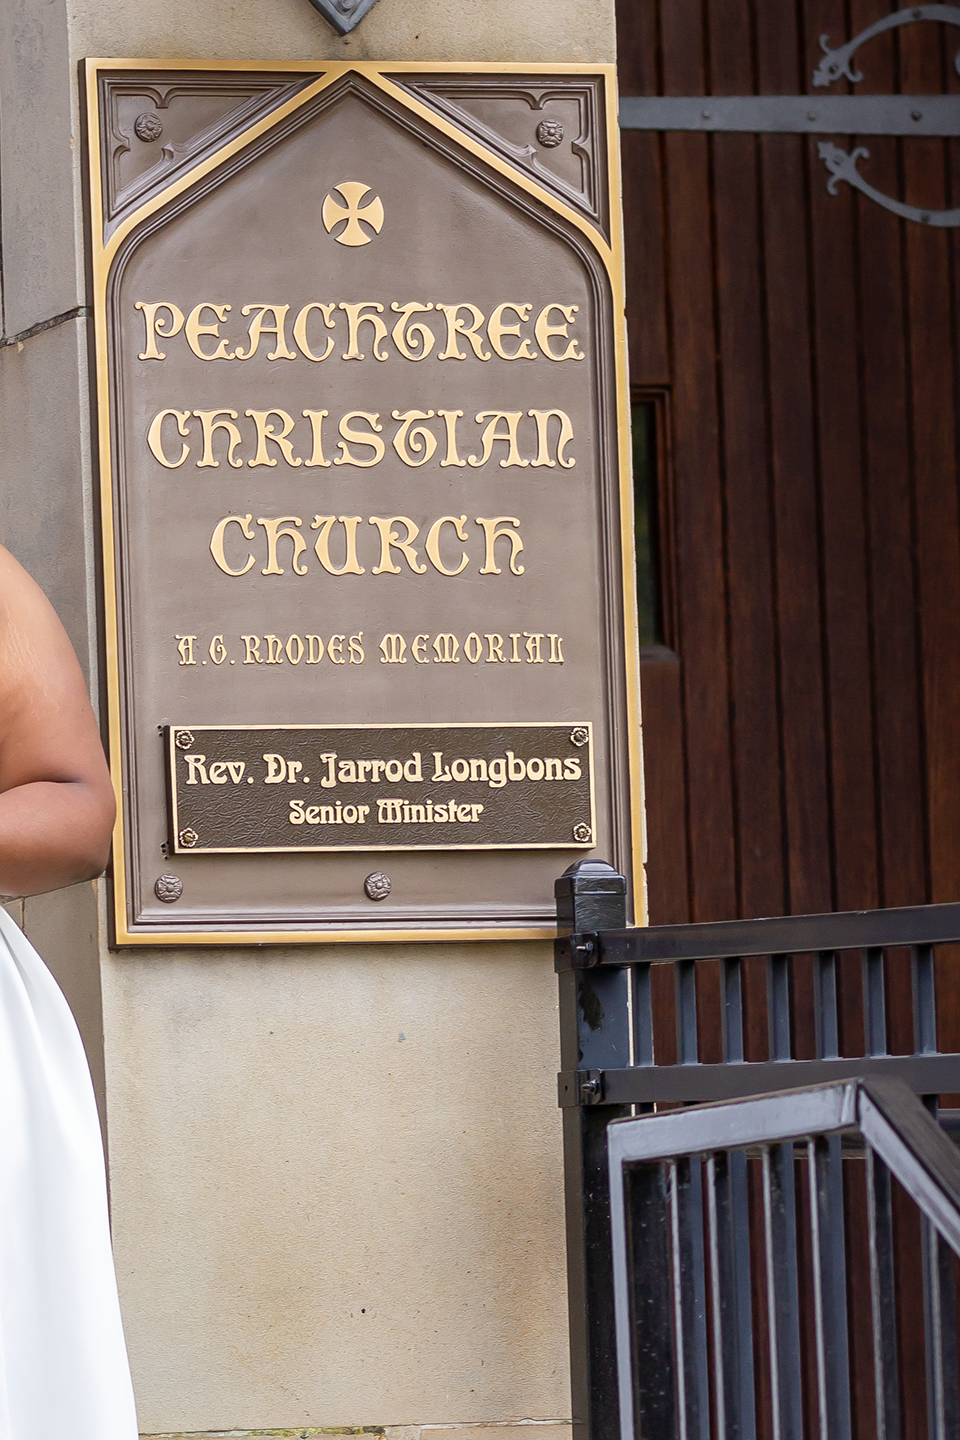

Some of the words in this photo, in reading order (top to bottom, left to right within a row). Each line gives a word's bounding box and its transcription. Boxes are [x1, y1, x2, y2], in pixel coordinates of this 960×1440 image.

[135, 301, 585, 362] PEACHTREE
[147, 408, 577, 469] CHRISTIAN
[210, 513, 526, 576] CHURCH
[241, 631, 366, 665] RHODES
[378, 631, 566, 665] MEMORIAL
[183, 753, 255, 786] Rev.
[262, 753, 311, 784] Dr.
[319, 751, 423, 789] Jarrod
[430, 750, 584, 789] Longbons
[288, 799, 371, 826] Senior
[376, 797, 485, 825] Minister
